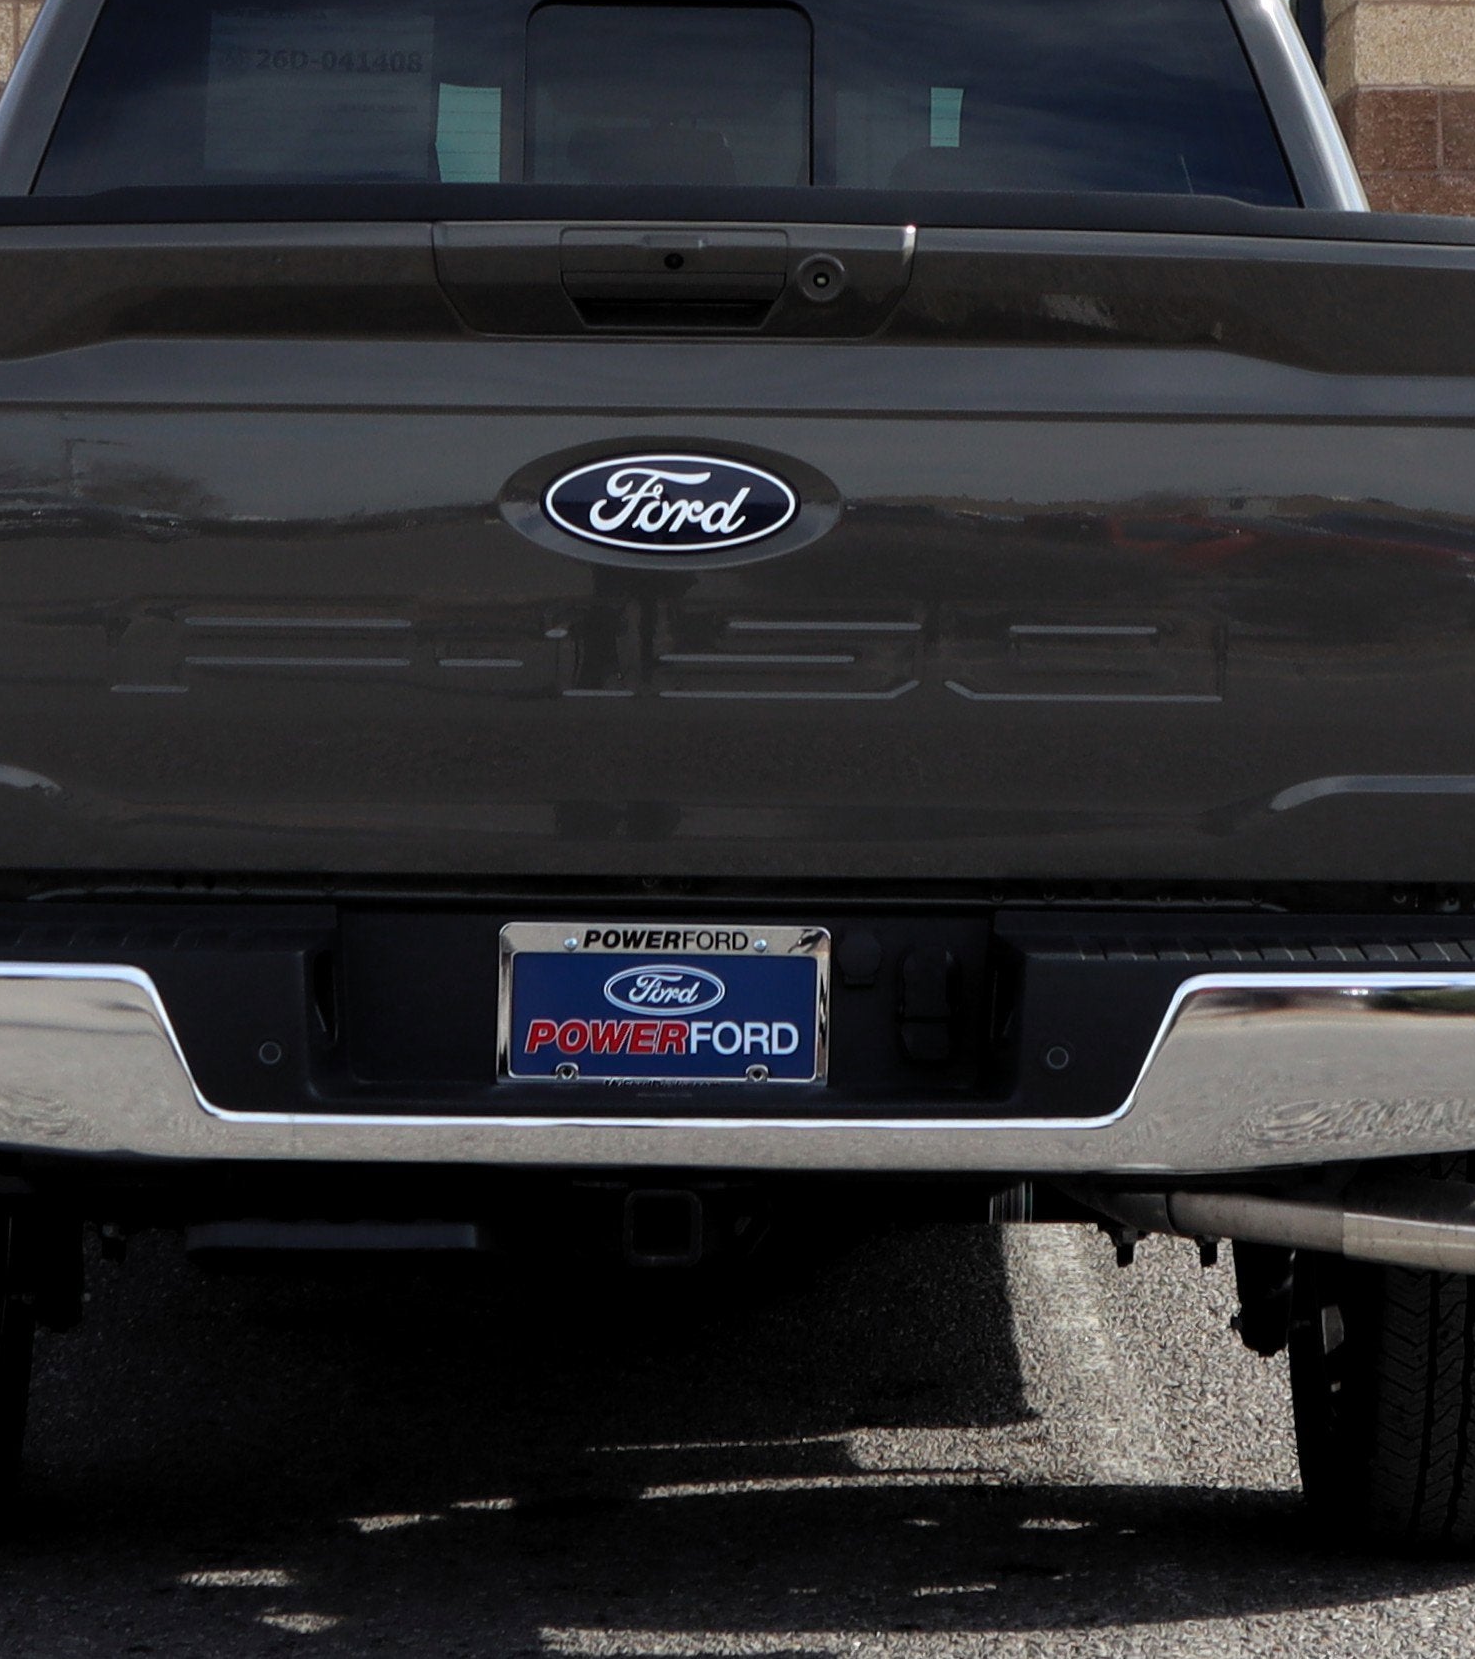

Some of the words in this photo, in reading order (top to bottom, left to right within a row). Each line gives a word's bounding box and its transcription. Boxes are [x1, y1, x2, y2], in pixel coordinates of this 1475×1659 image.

[589, 467, 751, 534] Ford
[583, 930, 748, 951] POWERFORD
[628, 973, 700, 1005] Ford
[525, 1019, 799, 1055] POWERFORD
